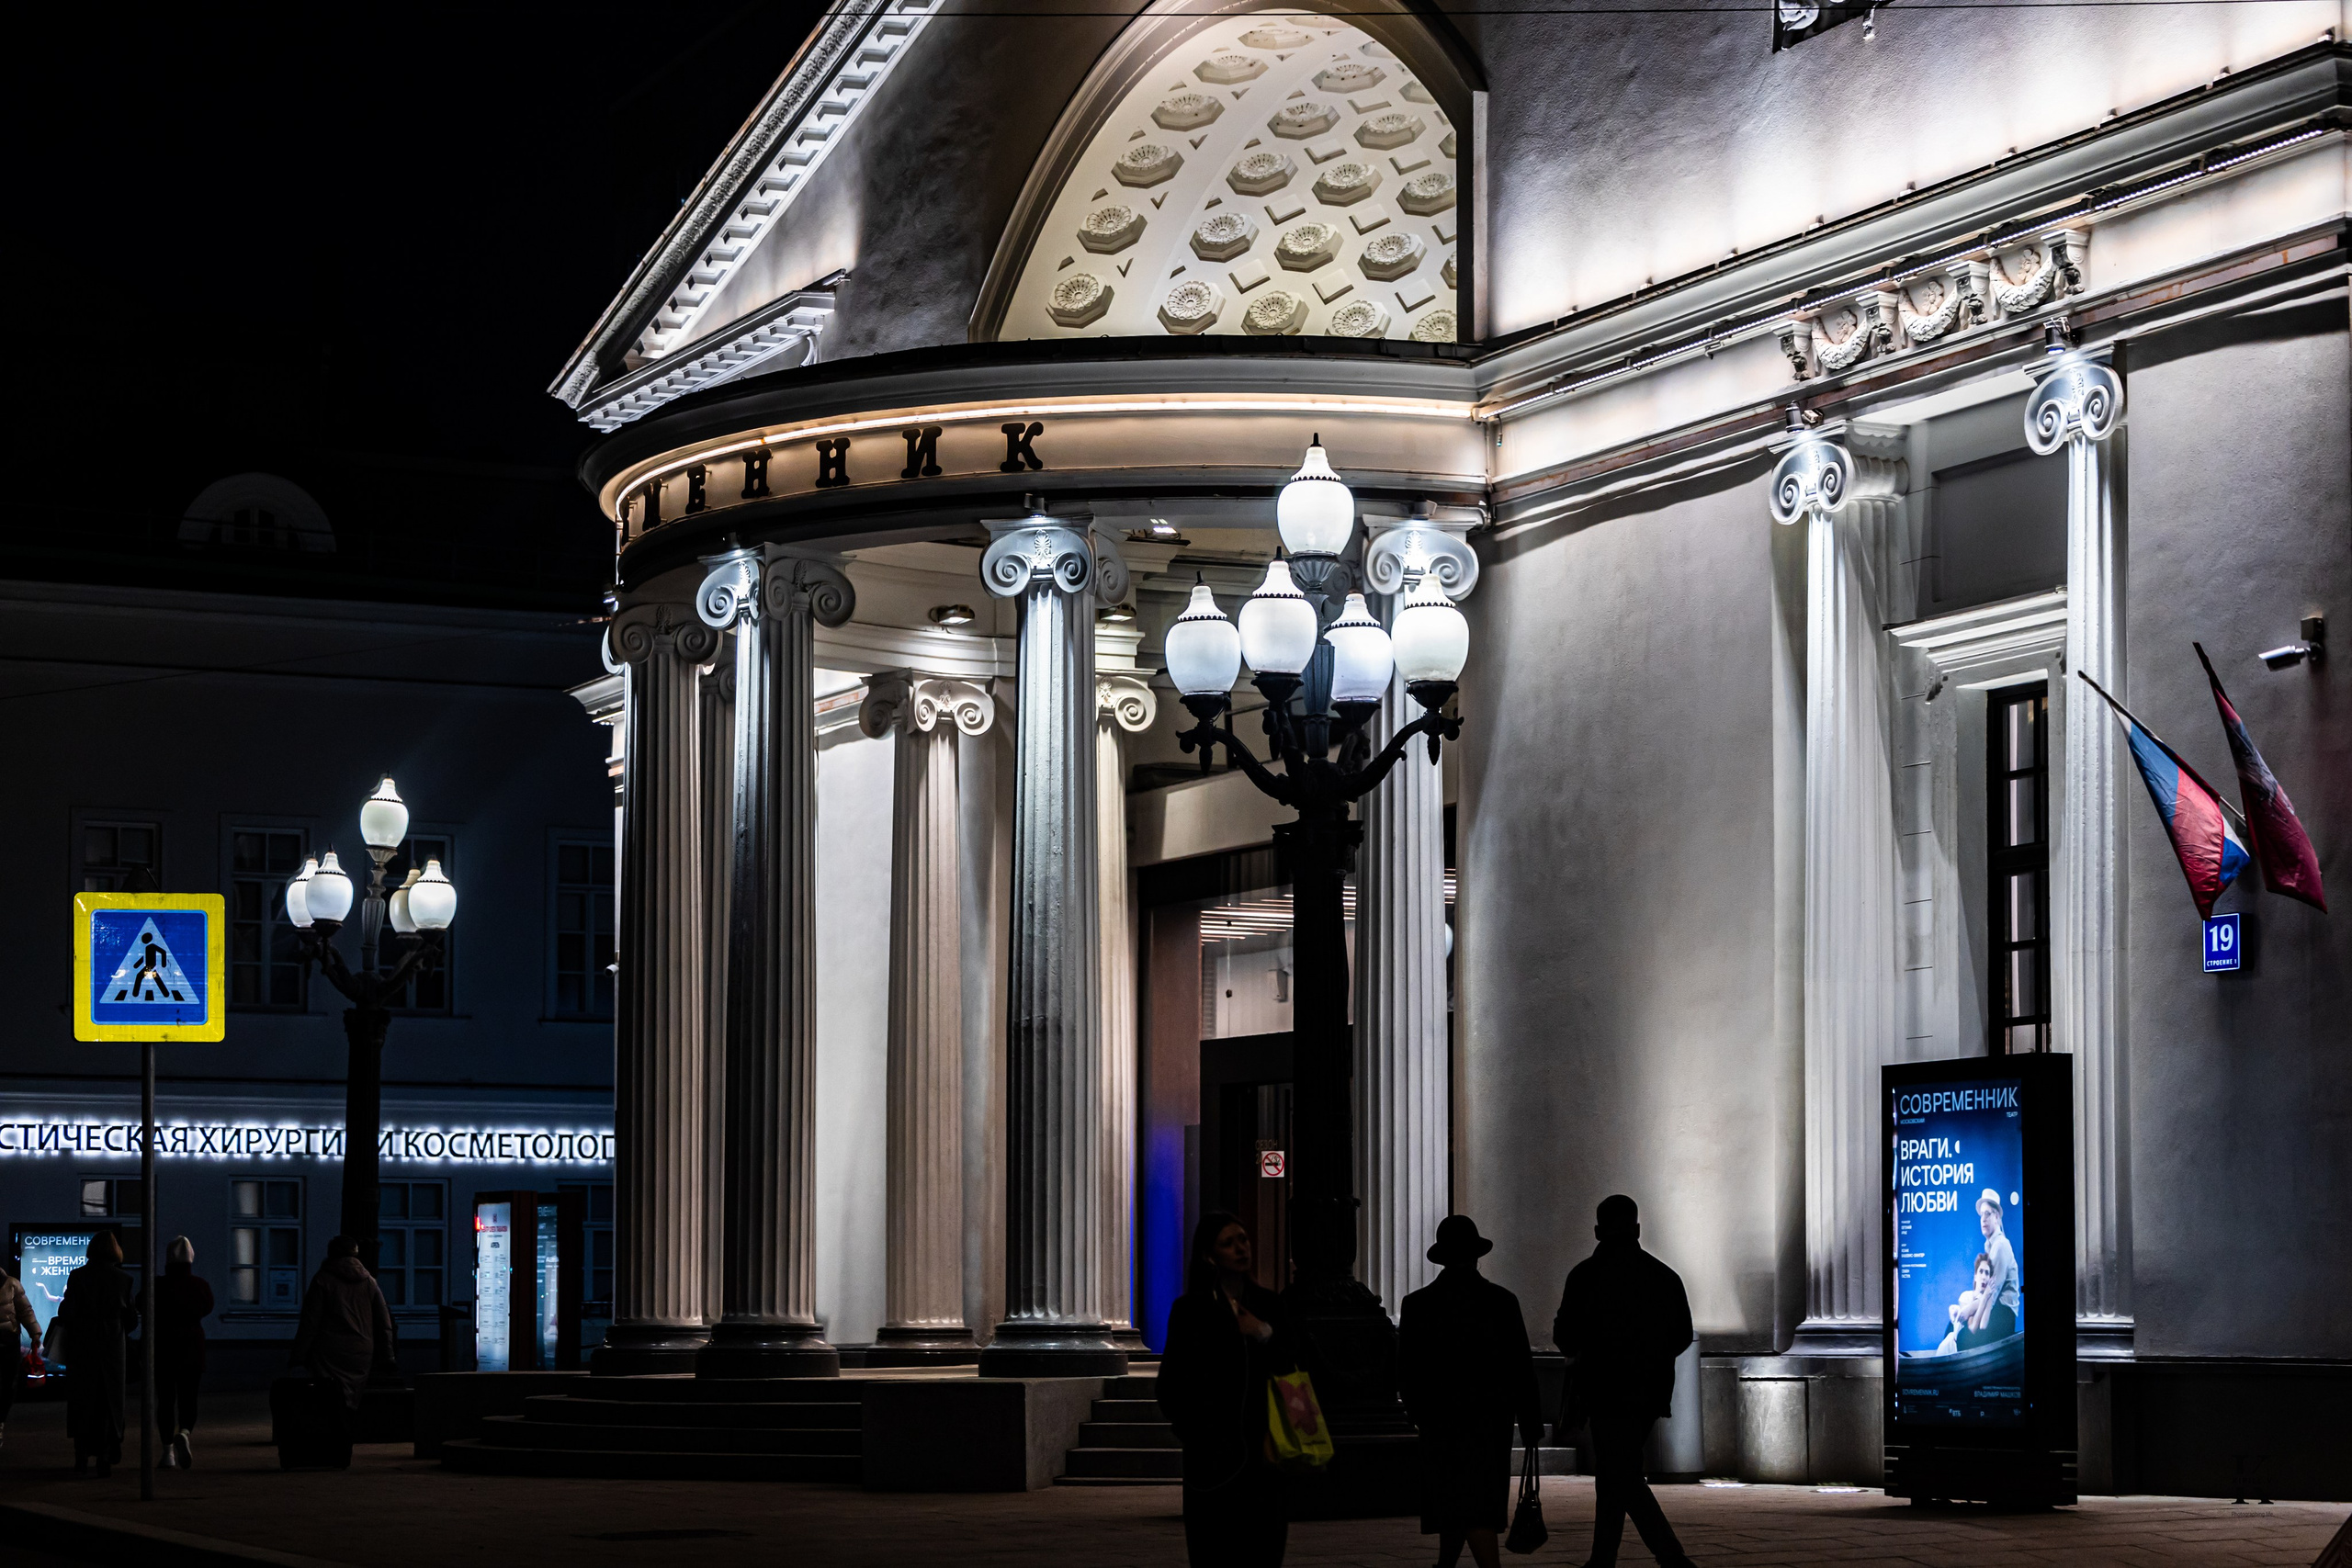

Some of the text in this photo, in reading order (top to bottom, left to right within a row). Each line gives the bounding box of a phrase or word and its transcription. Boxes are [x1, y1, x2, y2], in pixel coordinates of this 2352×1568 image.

[622, 422, 1044, 546] МЕННИК
[2209, 923, 2233, 952] 19
[2206, 958, 2233, 966] СТРОЕНИЕ
[1900, 1087, 2018, 1114] СОВРЕМЕННИК
[198, 1126, 343, 1156] ХИРУРГИ
[1900, 1137, 1952, 1160] ВРАГИ.
[1901, 1163, 1974, 1186] ИСТОРИЯ
[1900, 1190, 1958, 1213] ЛЮБВИ
[48, 1256, 85, 1265] ВРЕМЯ
